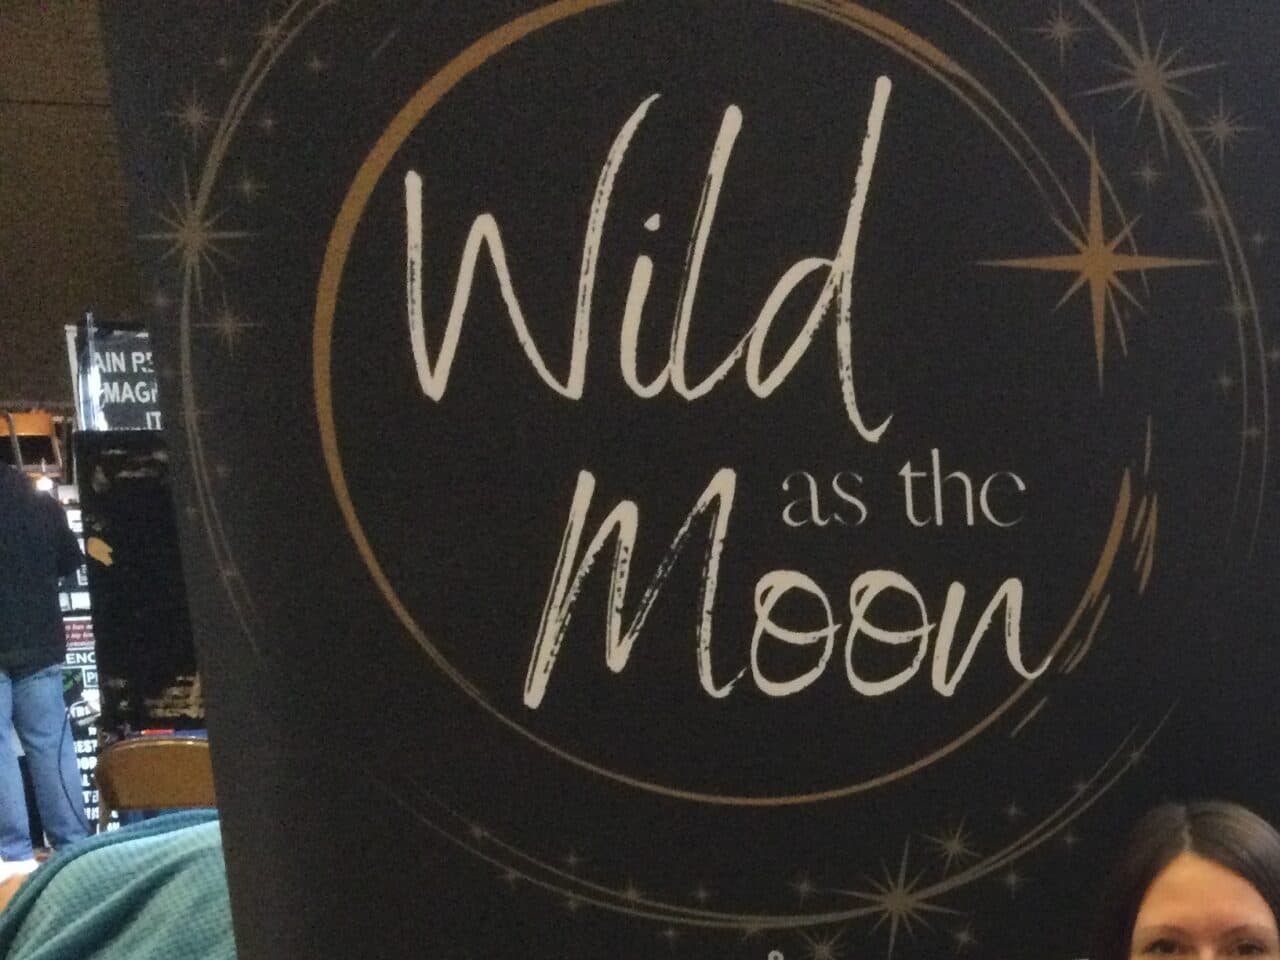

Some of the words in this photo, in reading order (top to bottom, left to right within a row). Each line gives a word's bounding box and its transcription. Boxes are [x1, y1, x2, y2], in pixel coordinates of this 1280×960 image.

[405, 75, 894, 442] Wild
[523, 467, 1052, 709] Moon
[781, 470, 868, 527] as
[898, 448, 1027, 527] the
